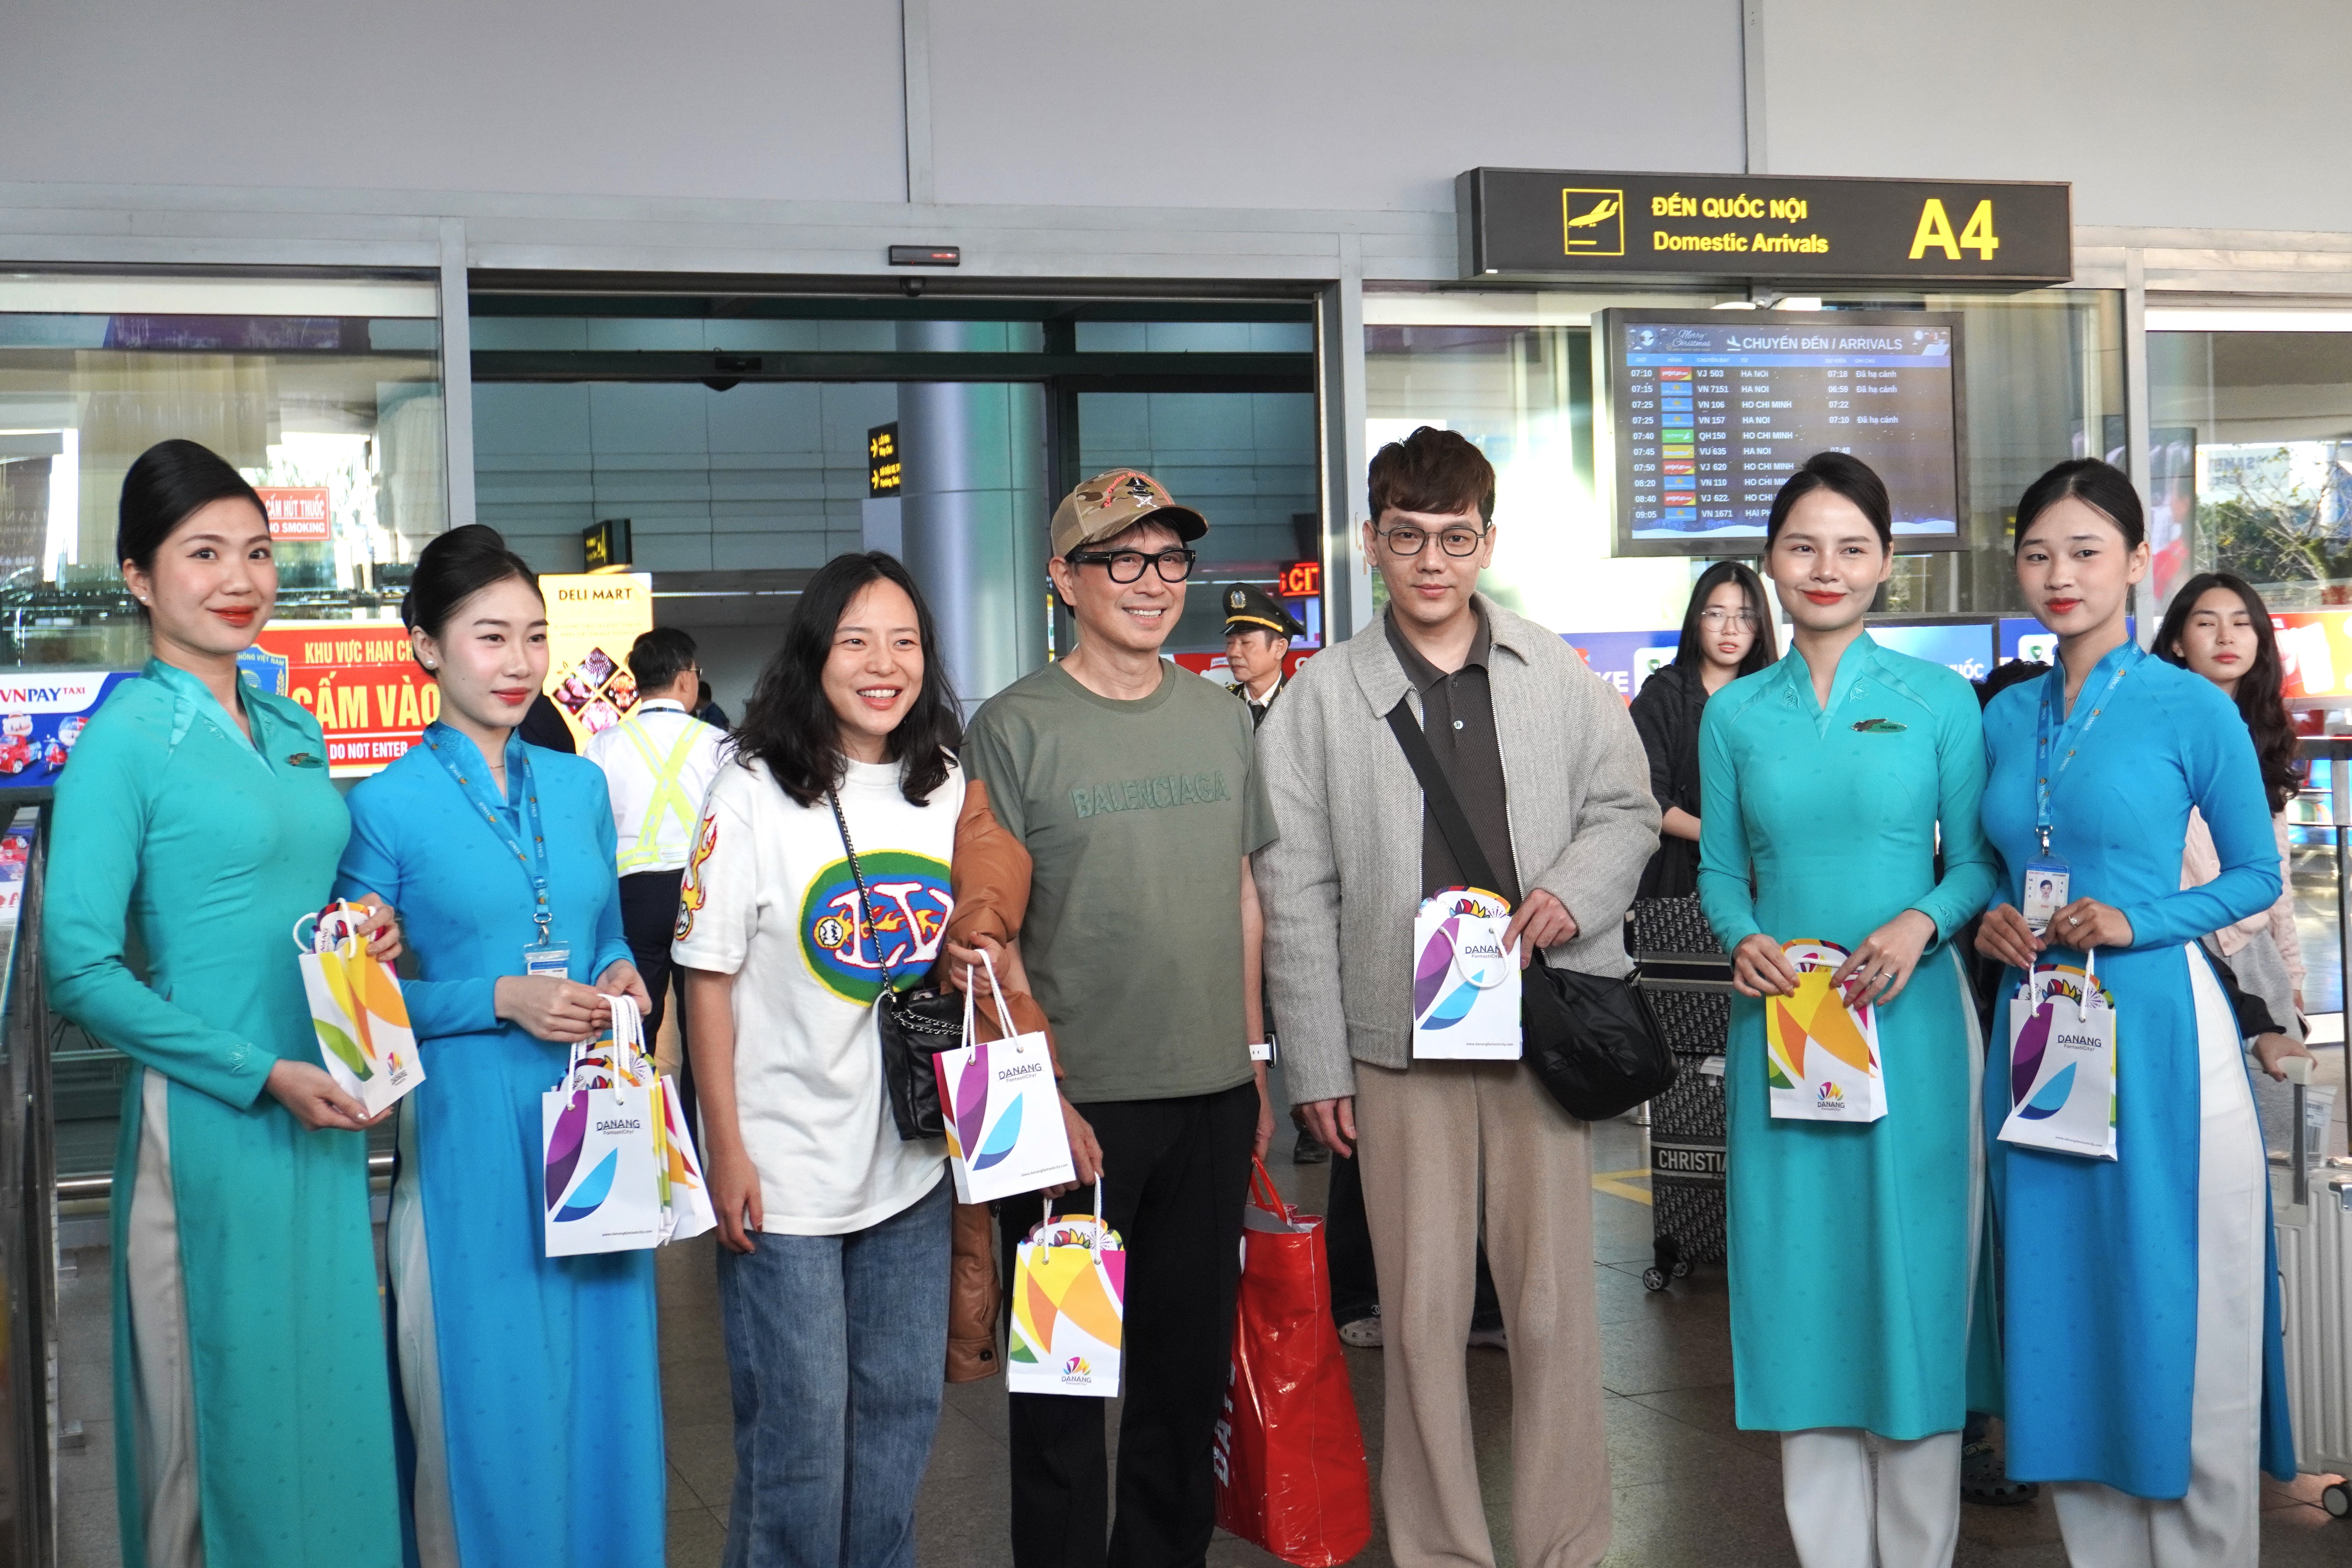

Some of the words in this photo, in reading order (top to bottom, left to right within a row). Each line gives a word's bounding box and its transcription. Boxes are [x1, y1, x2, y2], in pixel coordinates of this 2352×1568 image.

[1652, 192, 1696, 217] ĐẾN
[1702, 194, 1765, 219] QUỐC
[1770, 198, 1807, 223] NỘI
[1908, 198, 1998, 260] A4
[1653, 231, 1748, 251] Domestic
[1752, 233, 1828, 253] Arrivals
[1678, 329, 1706, 340] Merry
[1672, 338, 1711, 347] Christmas
[1743, 335, 1797, 349] CHUYẾN
[1801, 335, 1828, 349] ĐẾN
[1832, 338, 1836, 349] /
[1839, 338, 1902, 350] ARRIVALS
[1699, 432, 1711, 441] QH
[265, 493, 282, 517] CẤM
[283, 495, 299, 517] HÚT
[300, 493, 325, 517] THUỐC
[282, 522, 325, 533] SMOKING
[559, 589, 587, 601] DELI
[592, 588, 632, 600] MART
[305, 642, 333, 663] KHU
[335, 639, 362, 667] VỰC
[365, 640, 393, 666] HẠN
[397, 639, 414, 661] CH
[0, 688, 61, 703] VNPAY
[376, 675, 441, 726] VÀO
[330, 744, 346, 759] DO
[348, 743, 370, 759] NOT
[373, 741, 408, 757] ENTER
[1071, 771, 1231, 818] BALENCIAGA
[1465, 945, 1500, 954] DANAN
[2058, 1035, 2101, 1047] DANANG
[999, 1063, 1042, 1080] DANANG
[596, 1119, 640, 1131] DANANG
